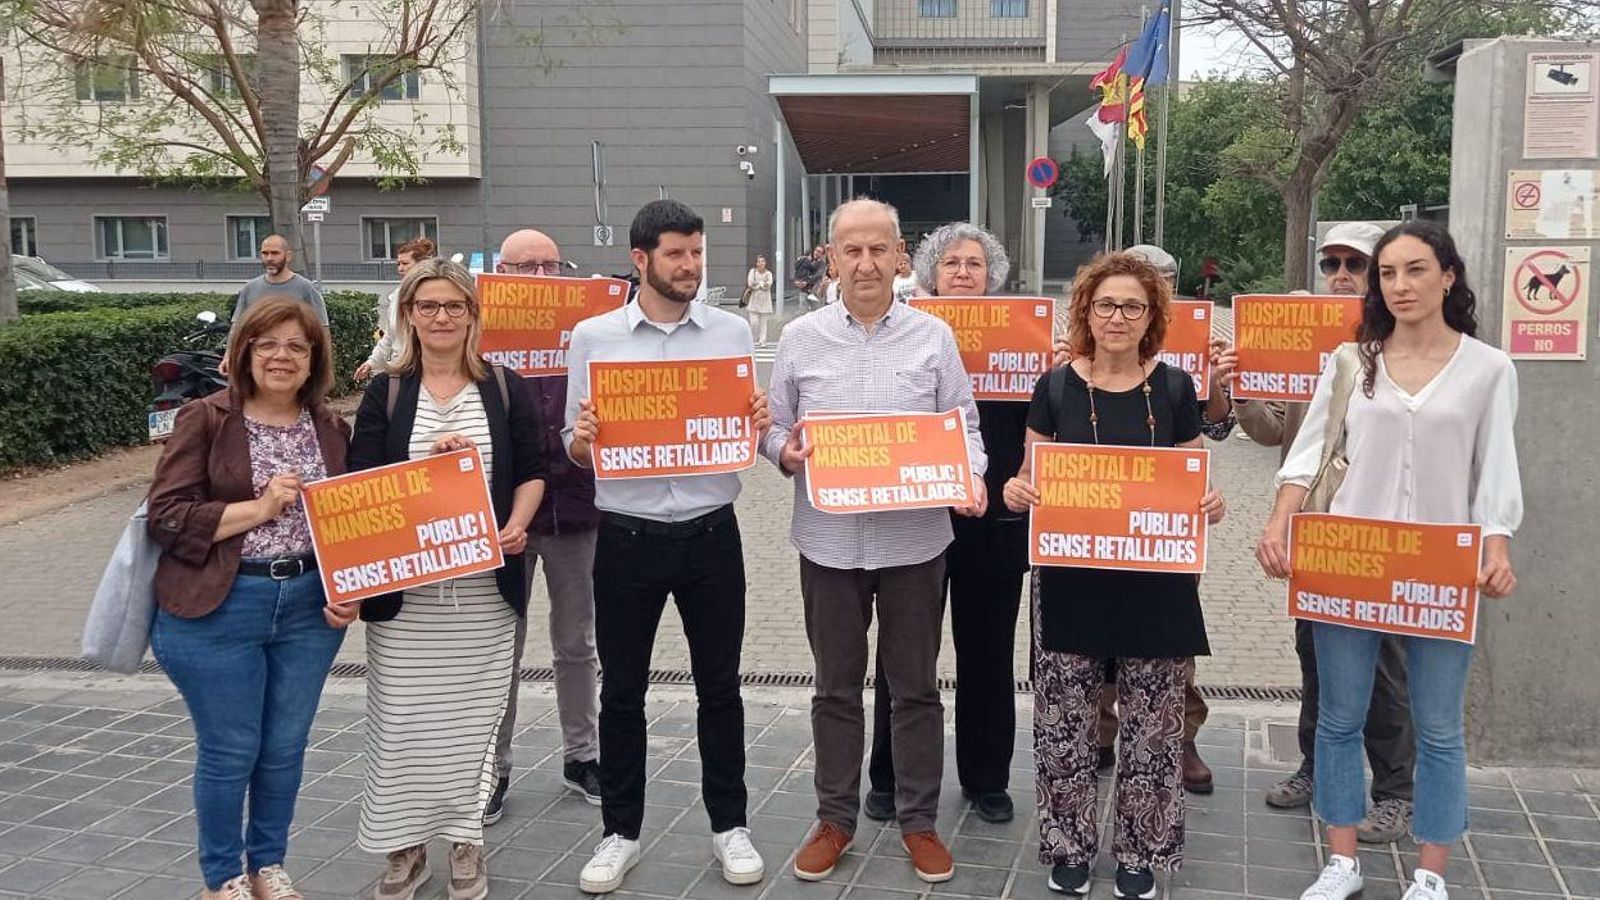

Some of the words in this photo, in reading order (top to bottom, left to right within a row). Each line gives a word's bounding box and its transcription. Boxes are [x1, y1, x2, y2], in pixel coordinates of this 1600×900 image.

[482, 281, 562, 306] HOSPITAL
[566, 286, 586, 307] DE
[482, 307, 556, 330] MANISES
[990, 304, 1010, 327] DE
[1240, 301, 1319, 326] HOSPITAL
[1322, 303, 1344, 327] DE
[1239, 326, 1313, 351] MANISES
[1518, 323, 1571, 336] PERROS
[1534, 338, 1553, 352] NO
[988, 348, 1038, 371] PÚBLIC
[1041, 352, 1047, 372] I
[1199, 353, 1204, 372] I
[597, 367, 682, 395] HOSPITAL
[686, 367, 708, 392] DE
[970, 373, 1040, 394] ETALLADE
[1239, 371, 1286, 393] SENSE
[597, 395, 678, 422] MANISES
[686, 414, 741, 441] PÚBLIC
[745, 416, 750, 438] I
[811, 423, 894, 446] HOSPITAL
[896, 421, 917, 444] DE
[600, 446, 652, 471] SENSE
[655, 441, 750, 468] RETALLADES
[813, 446, 891, 468] MANISES
[1041, 452, 1128, 481] HOSPITAL
[1132, 456, 1156, 483] DE
[959, 464, 964, 482] I
[311, 472, 406, 517] HOSPITAL
[405, 468, 432, 496] DE
[818, 487, 868, 506] SENSE
[871, 483, 967, 504] RETALLADES
[1040, 480, 1122, 510] MANISES
[319, 503, 406, 545] MANISES
[416, 514, 479, 549] PÚBLIC
[477, 511, 488, 535] I
[1129, 507, 1188, 536] PÚBLIC
[1192, 513, 1198, 538] I
[1039, 533, 1091, 558] SENSE
[1094, 535, 1196, 564] RETALLADES
[1297, 520, 1392, 554] HOSPITAL
[1397, 529, 1423, 555] DE
[333, 561, 390, 594] SENSE
[390, 539, 492, 582] RETALLADES
[1296, 545, 1385, 578] MANISES
[1392, 578, 1458, 608] PÚBLIC
[1461, 587, 1467, 608] I
[1296, 591, 1351, 618] SENSE
[1355, 600, 1466, 632] RETALLADES
